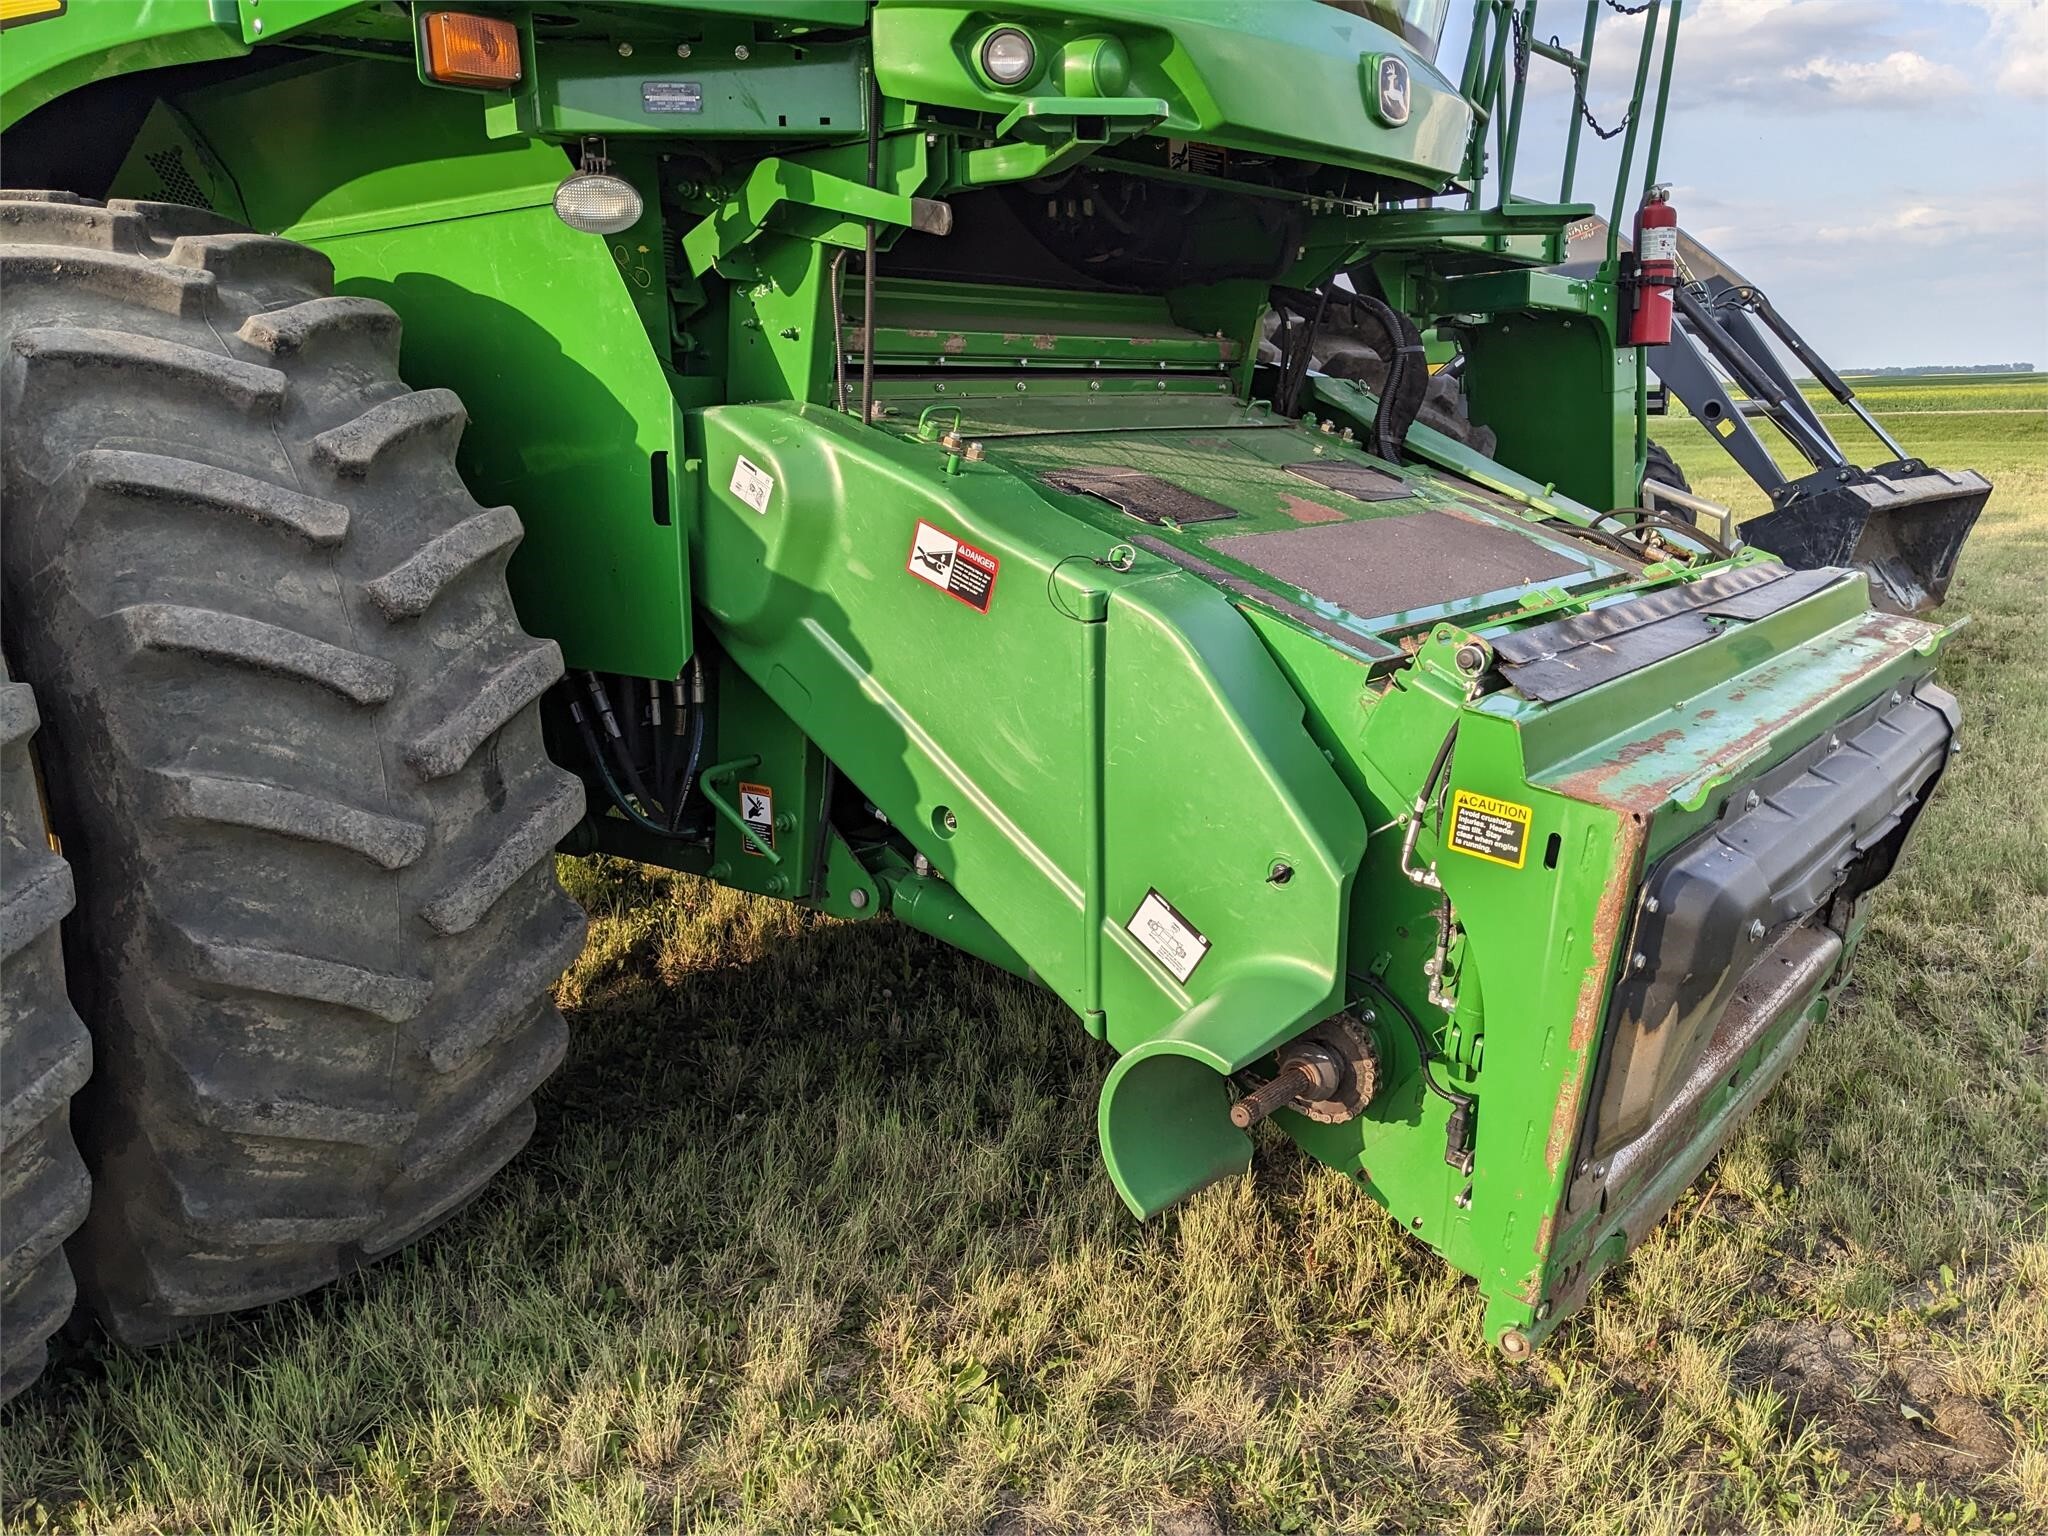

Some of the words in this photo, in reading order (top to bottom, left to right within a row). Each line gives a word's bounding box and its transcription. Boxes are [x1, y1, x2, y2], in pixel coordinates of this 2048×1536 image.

[964, 548, 996, 571] DANGER
[1460, 808, 1480, 819] Avoid
[1481, 814, 1512, 829] crushing
[1469, 796, 1527, 820] CAUTION
[1457, 824, 1471, 832] can
[1485, 830, 1502, 841] Stay
[1489, 823, 1515, 836] Header
[1456, 831, 1474, 840] clear
[1474, 835, 1494, 845] when
[1494, 841, 1518, 853] engine
[1462, 839, 1492, 854] running.
